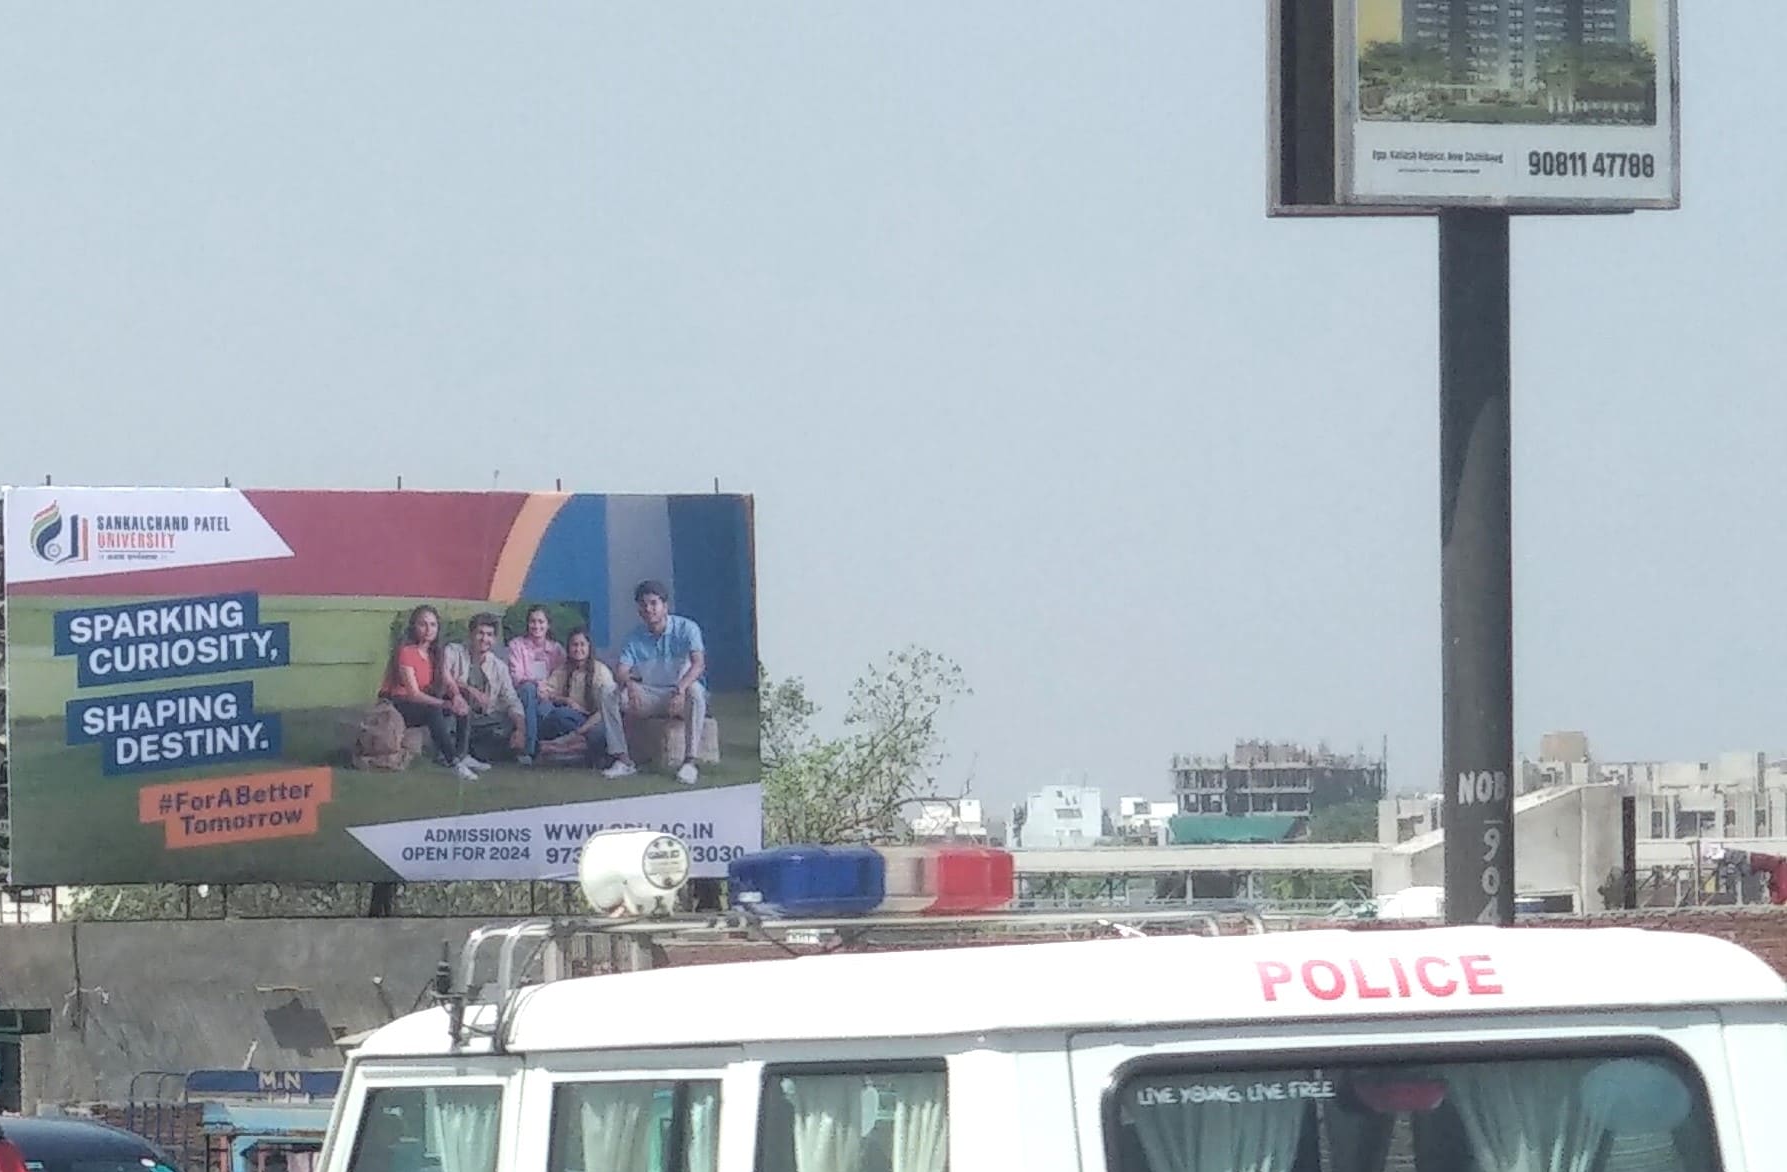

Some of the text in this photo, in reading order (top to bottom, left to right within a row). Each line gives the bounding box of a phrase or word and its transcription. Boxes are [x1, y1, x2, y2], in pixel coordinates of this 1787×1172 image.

[1528, 151, 1655, 178] 90811 47788
[96, 515, 231, 532] SANKALCHAND PATEL
[97, 531, 176, 549] UNIVERSITY
[69, 600, 244, 644] SPARKING
[88, 630, 279, 675] CURIOSITY,
[82, 692, 238, 735] SHAPING
[115, 721, 270, 765] DESTINY.
[158, 781, 314, 815] #ForABetter
[179, 810, 304, 836] Tomorrow
[424, 827, 532, 843] ADMISSIONS
[402, 845, 531, 862] OPEN FOR 2024
[1255, 954, 1503, 1002] POLICE
[1137, 1086, 1178, 1105] LIVE
[1247, 1083, 1286, 1101] LIVE
[1288, 1080, 1336, 1099] FREE
